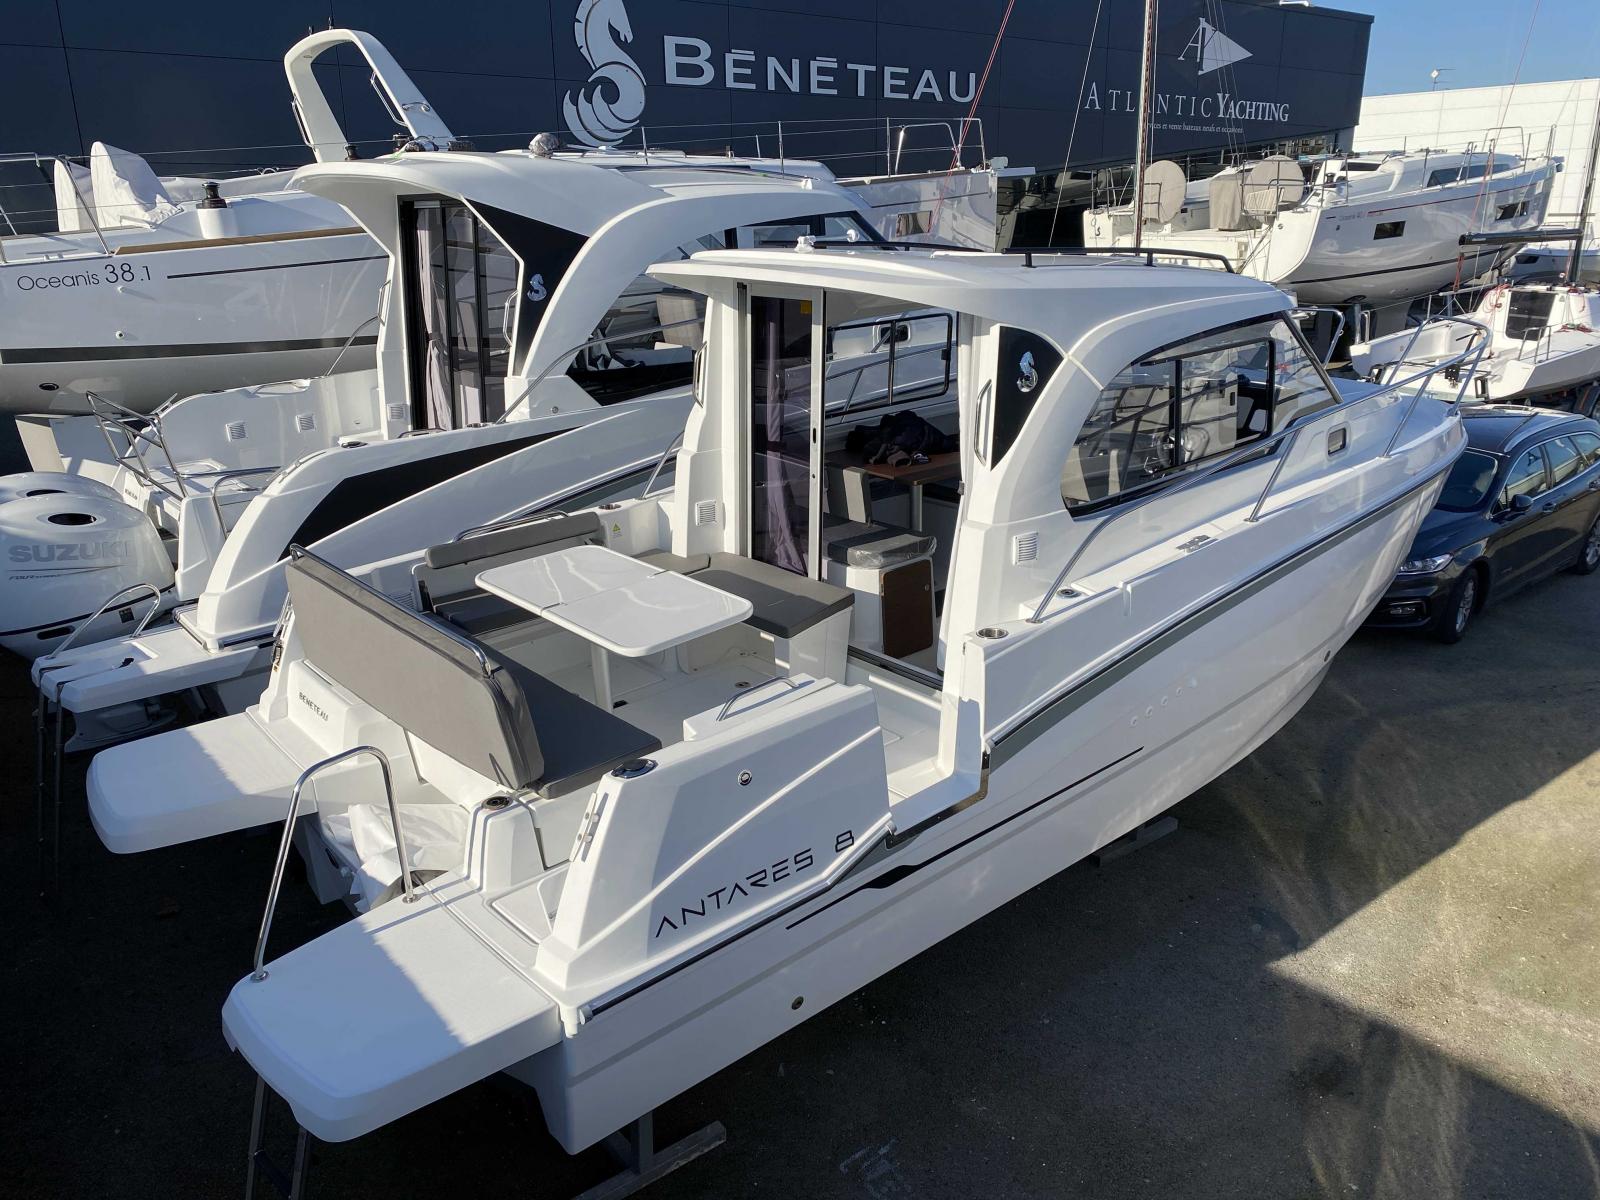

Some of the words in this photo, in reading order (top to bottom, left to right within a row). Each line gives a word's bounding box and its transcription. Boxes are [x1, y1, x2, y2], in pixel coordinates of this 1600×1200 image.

[1216, 92, 1289, 122] YACHTING
[17, 270, 100, 291] Oceanis
[8, 540, 129, 563] SUZUKI
[655, 848, 814, 938] ANTARES
[834, 829, 855, 852] 8
